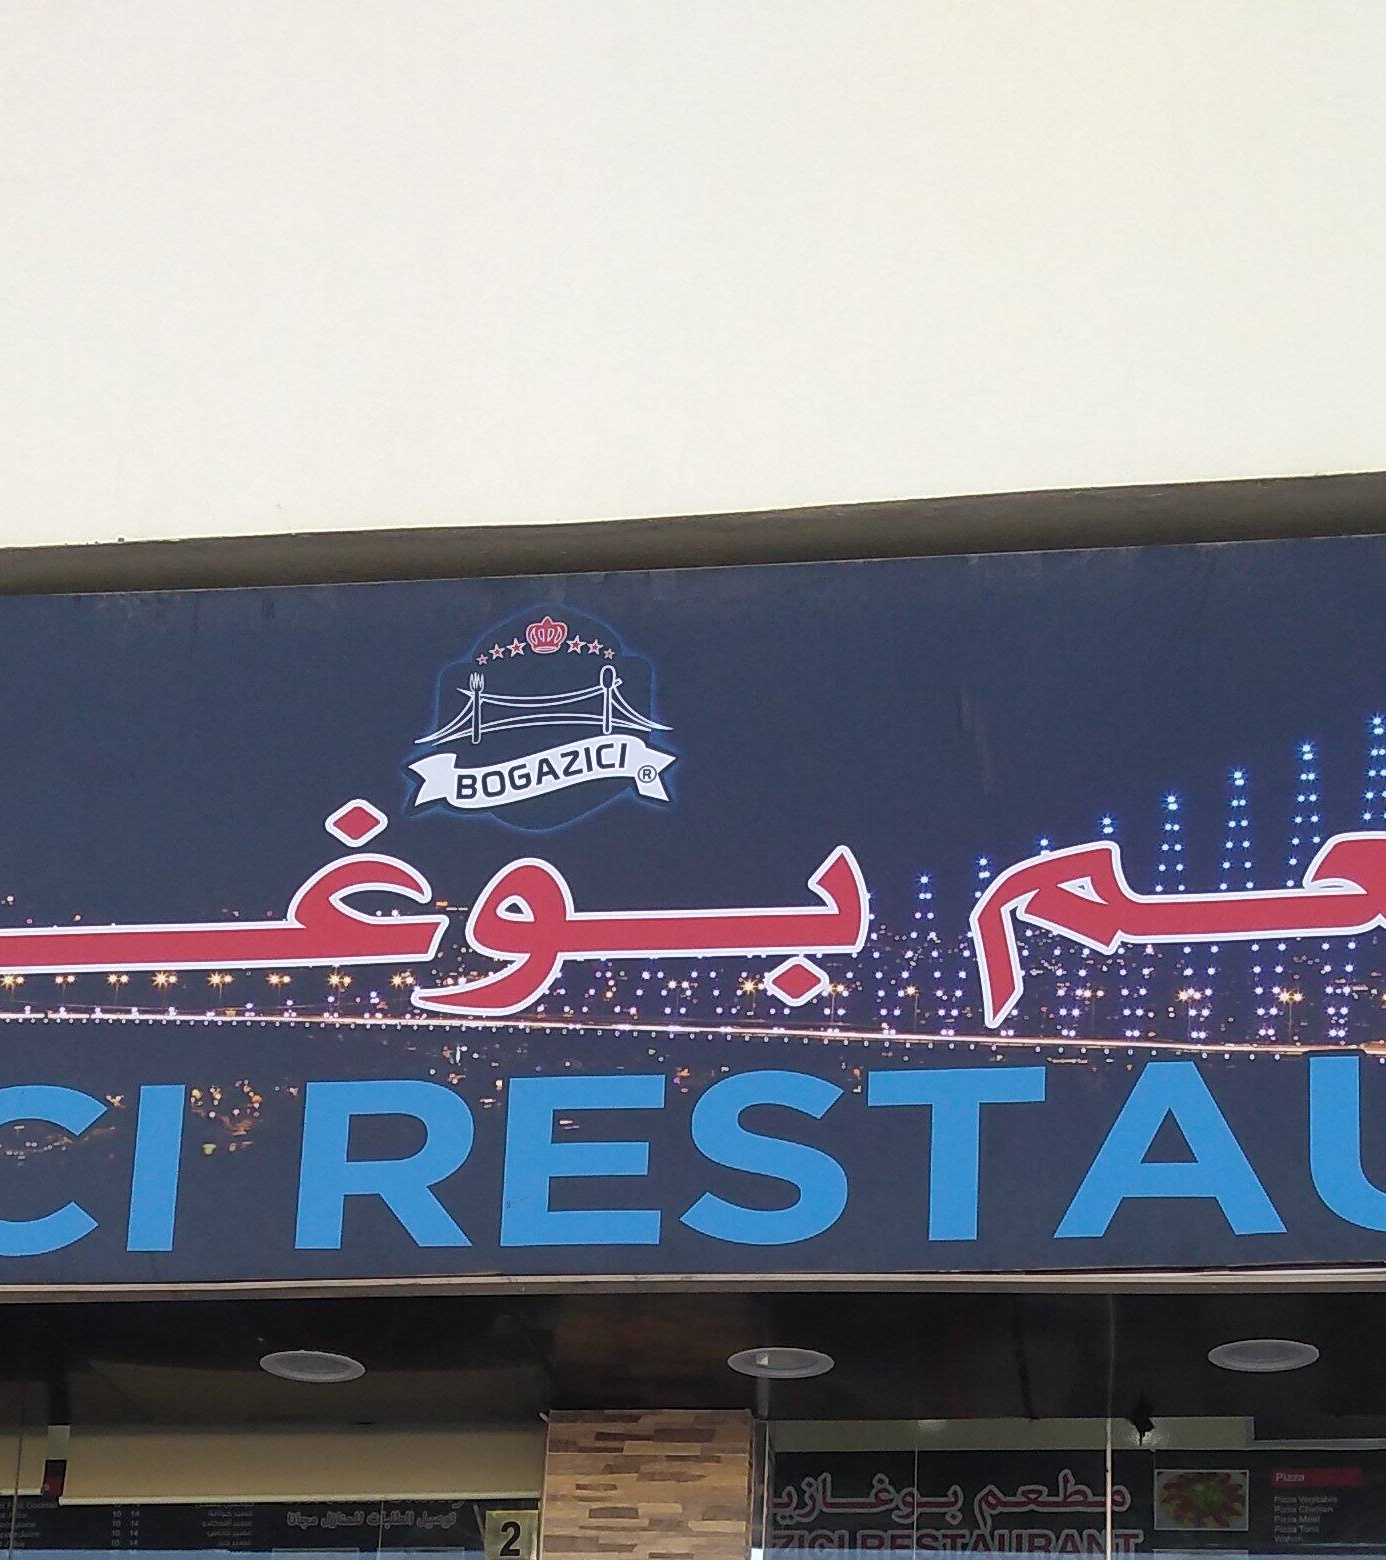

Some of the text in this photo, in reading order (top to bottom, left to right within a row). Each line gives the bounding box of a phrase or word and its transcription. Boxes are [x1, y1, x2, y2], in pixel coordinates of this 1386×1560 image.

[456, 742, 628, 801] BOGAZICI
[974, 1468, 1132, 1530] مطعم
[499, 1521, 522, 1557] 2
